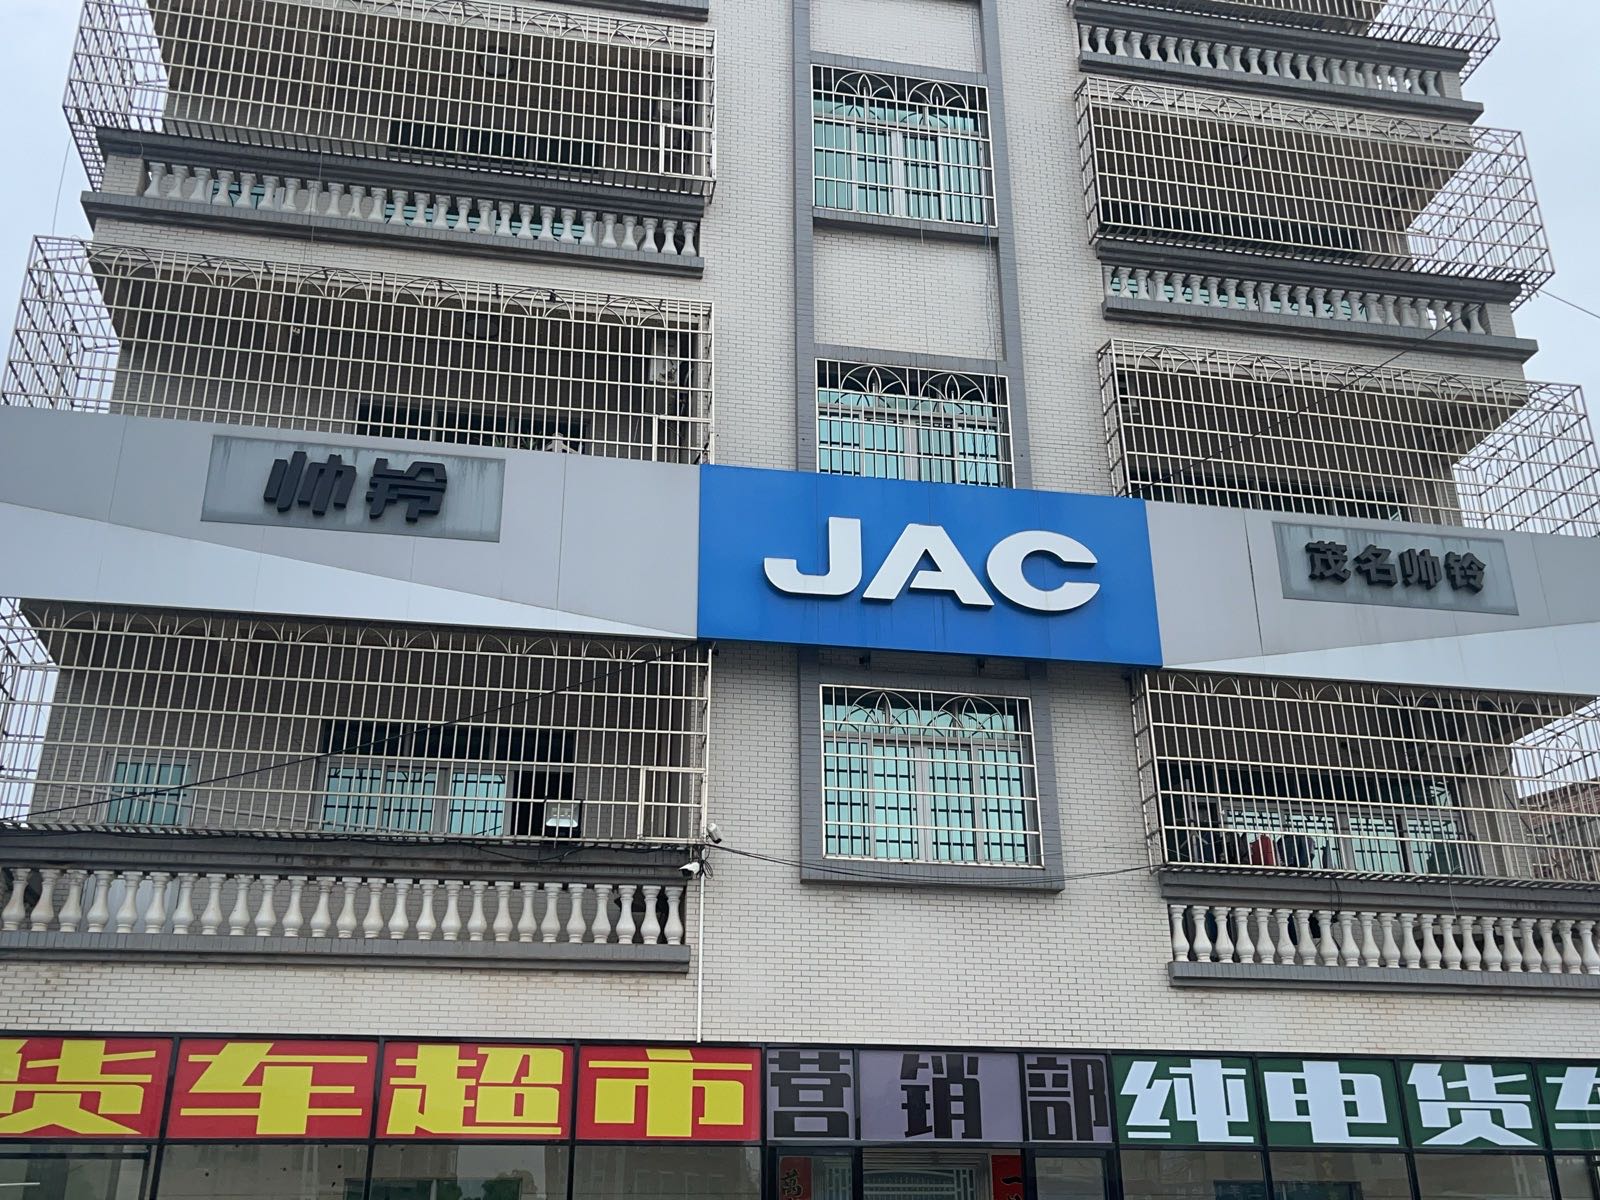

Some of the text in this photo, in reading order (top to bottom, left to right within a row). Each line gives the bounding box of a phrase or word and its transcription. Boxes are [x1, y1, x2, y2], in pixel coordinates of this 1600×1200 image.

[763, 516, 1101, 612] JAC
[1305, 541, 1487, 593] 茂名帅铃
[0, 1039, 753, 1138] 货车超市
[768, 1051, 1108, 1141] 营销部
